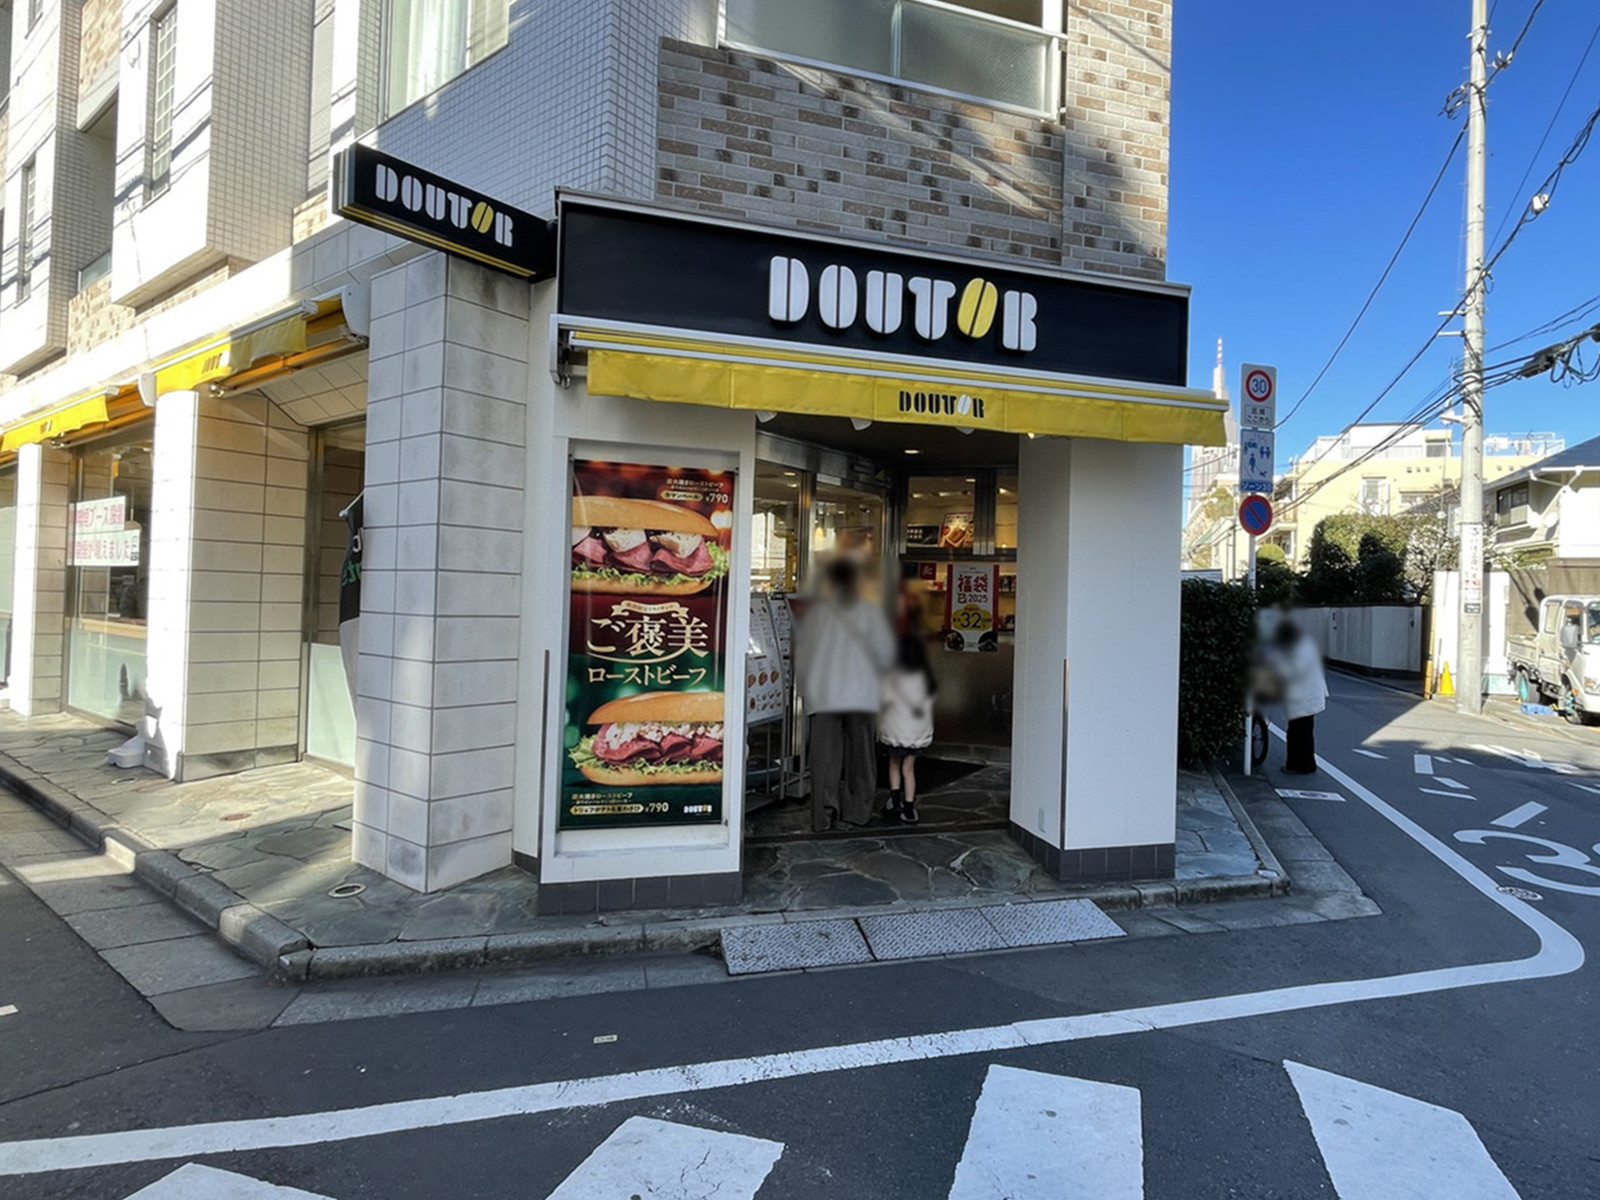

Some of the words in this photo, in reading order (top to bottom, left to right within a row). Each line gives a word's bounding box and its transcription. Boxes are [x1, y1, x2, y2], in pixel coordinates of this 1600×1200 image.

[375, 163, 514, 248] DOUTOR
[768, 255, 1038, 353] DOUTOR
[1252, 378, 1266, 394] 30
[898, 390, 985, 419] DOUTOR
[957, 573, 988, 593] 福袋
[586, 615, 710, 658] ご褒美
[588, 665, 708, 686] ローストビーフ
